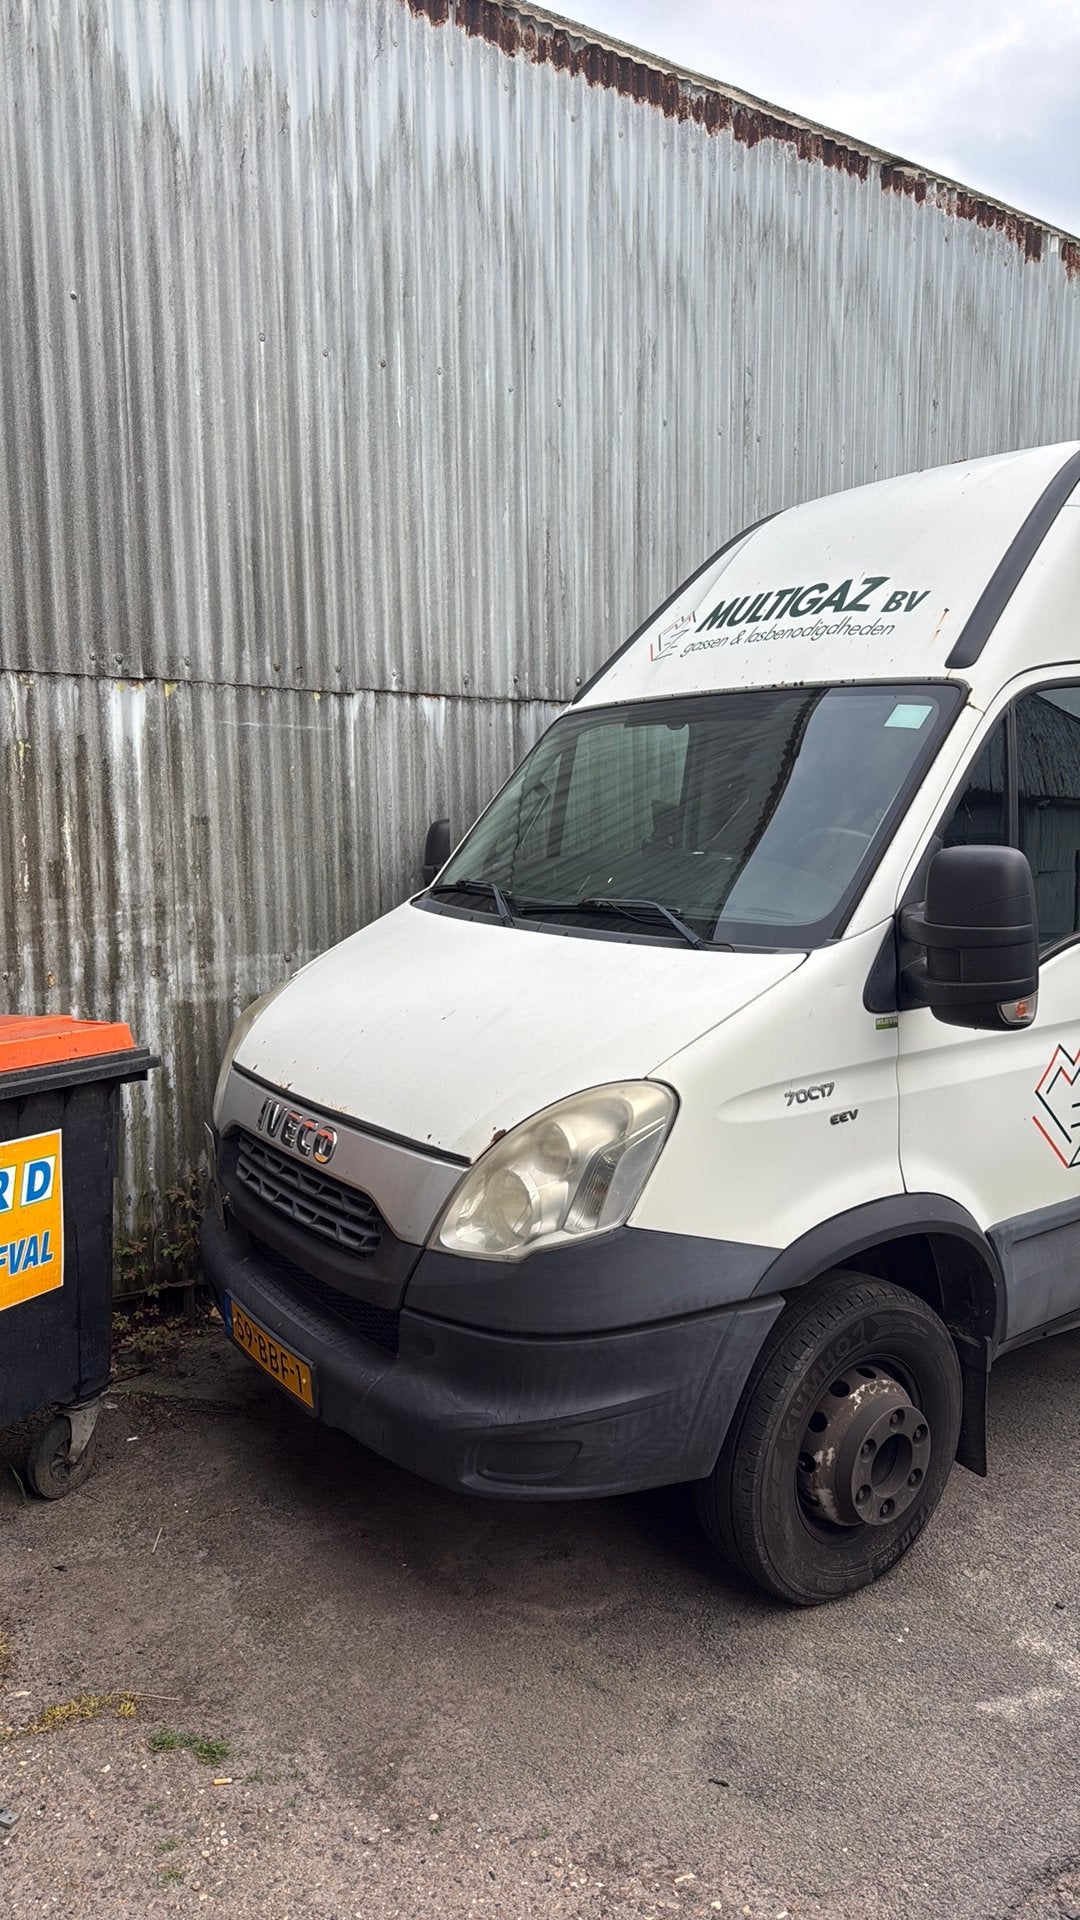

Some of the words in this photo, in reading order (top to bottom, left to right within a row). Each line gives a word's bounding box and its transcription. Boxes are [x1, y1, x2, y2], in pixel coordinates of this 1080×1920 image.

[695, 576, 890, 633] MULTIGAZ
[880, 590, 931, 613] BV
[680, 637, 728, 658] gassen
[729, 630, 742, 645] &
[745, 616, 895, 643] lasbenodigdheden
[784, 1082, 835, 1106] 70C17
[256, 1097, 338, 1165] IVECO
[829, 1109, 859, 1126] EEV
